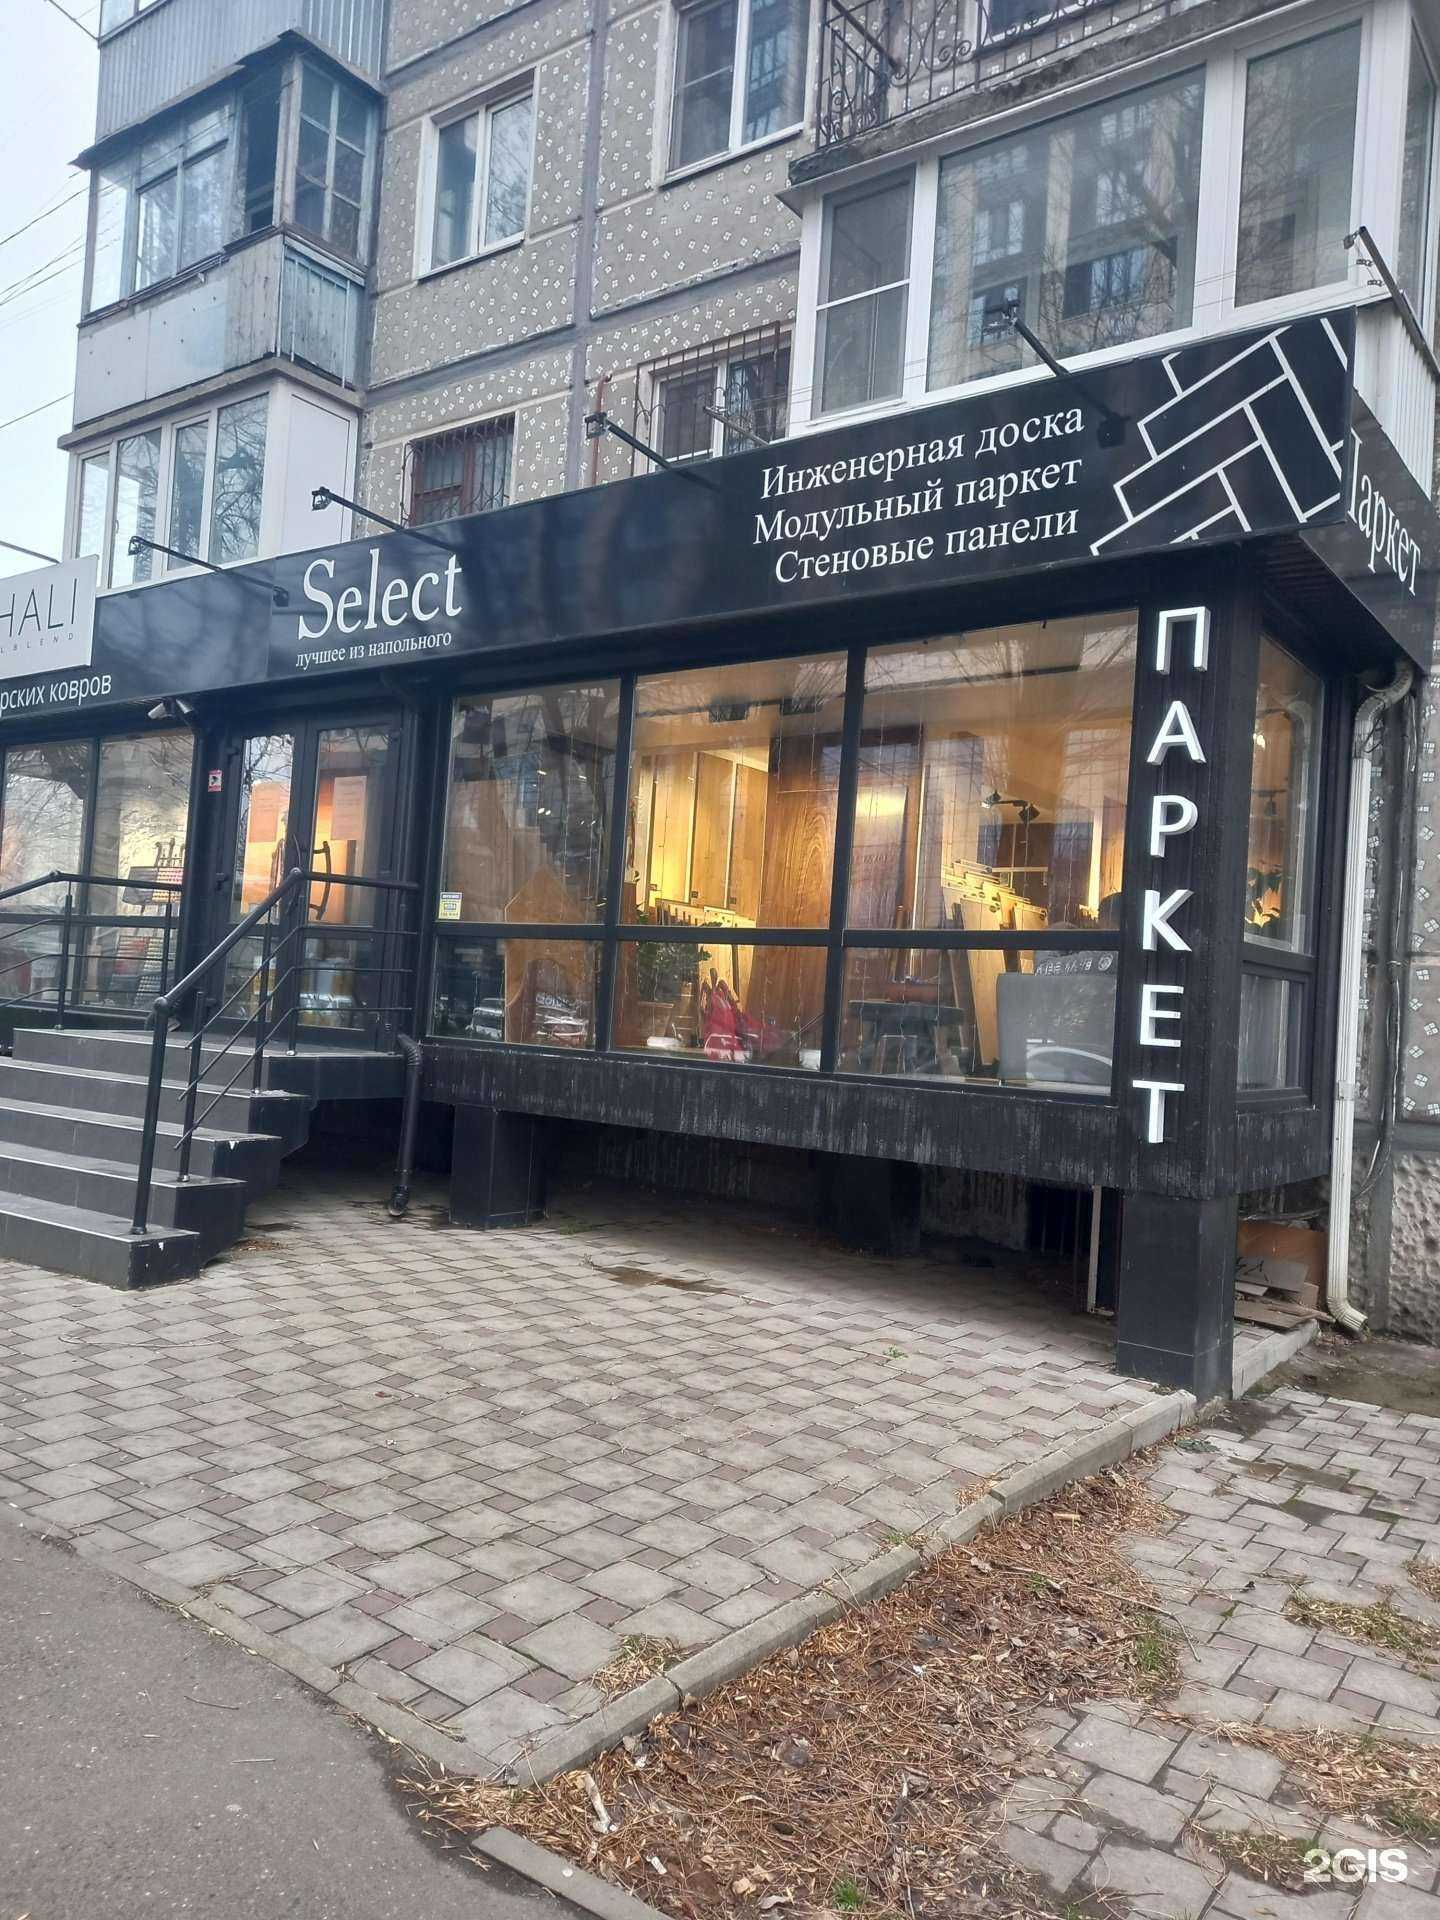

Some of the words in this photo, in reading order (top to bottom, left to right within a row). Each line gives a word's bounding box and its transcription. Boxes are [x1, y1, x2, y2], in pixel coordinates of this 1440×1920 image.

[760, 442, 966, 500] Инженерная
[974, 407, 1085, 460] доска
[752, 478, 945, 545] Модульный
[954, 458, 1083, 509] паркет
[774, 535, 935, 583] Стеновые
[944, 508, 1080, 556] панели
[298, 547, 463, 641] Select
[49, 674, 112, 707] ковров
[295, 647, 346, 671] лучшее
[349, 643, 365, 659] из
[368, 631, 453, 658] напольного
[1131, 605, 1212, 1144] ПАРКЕТ
